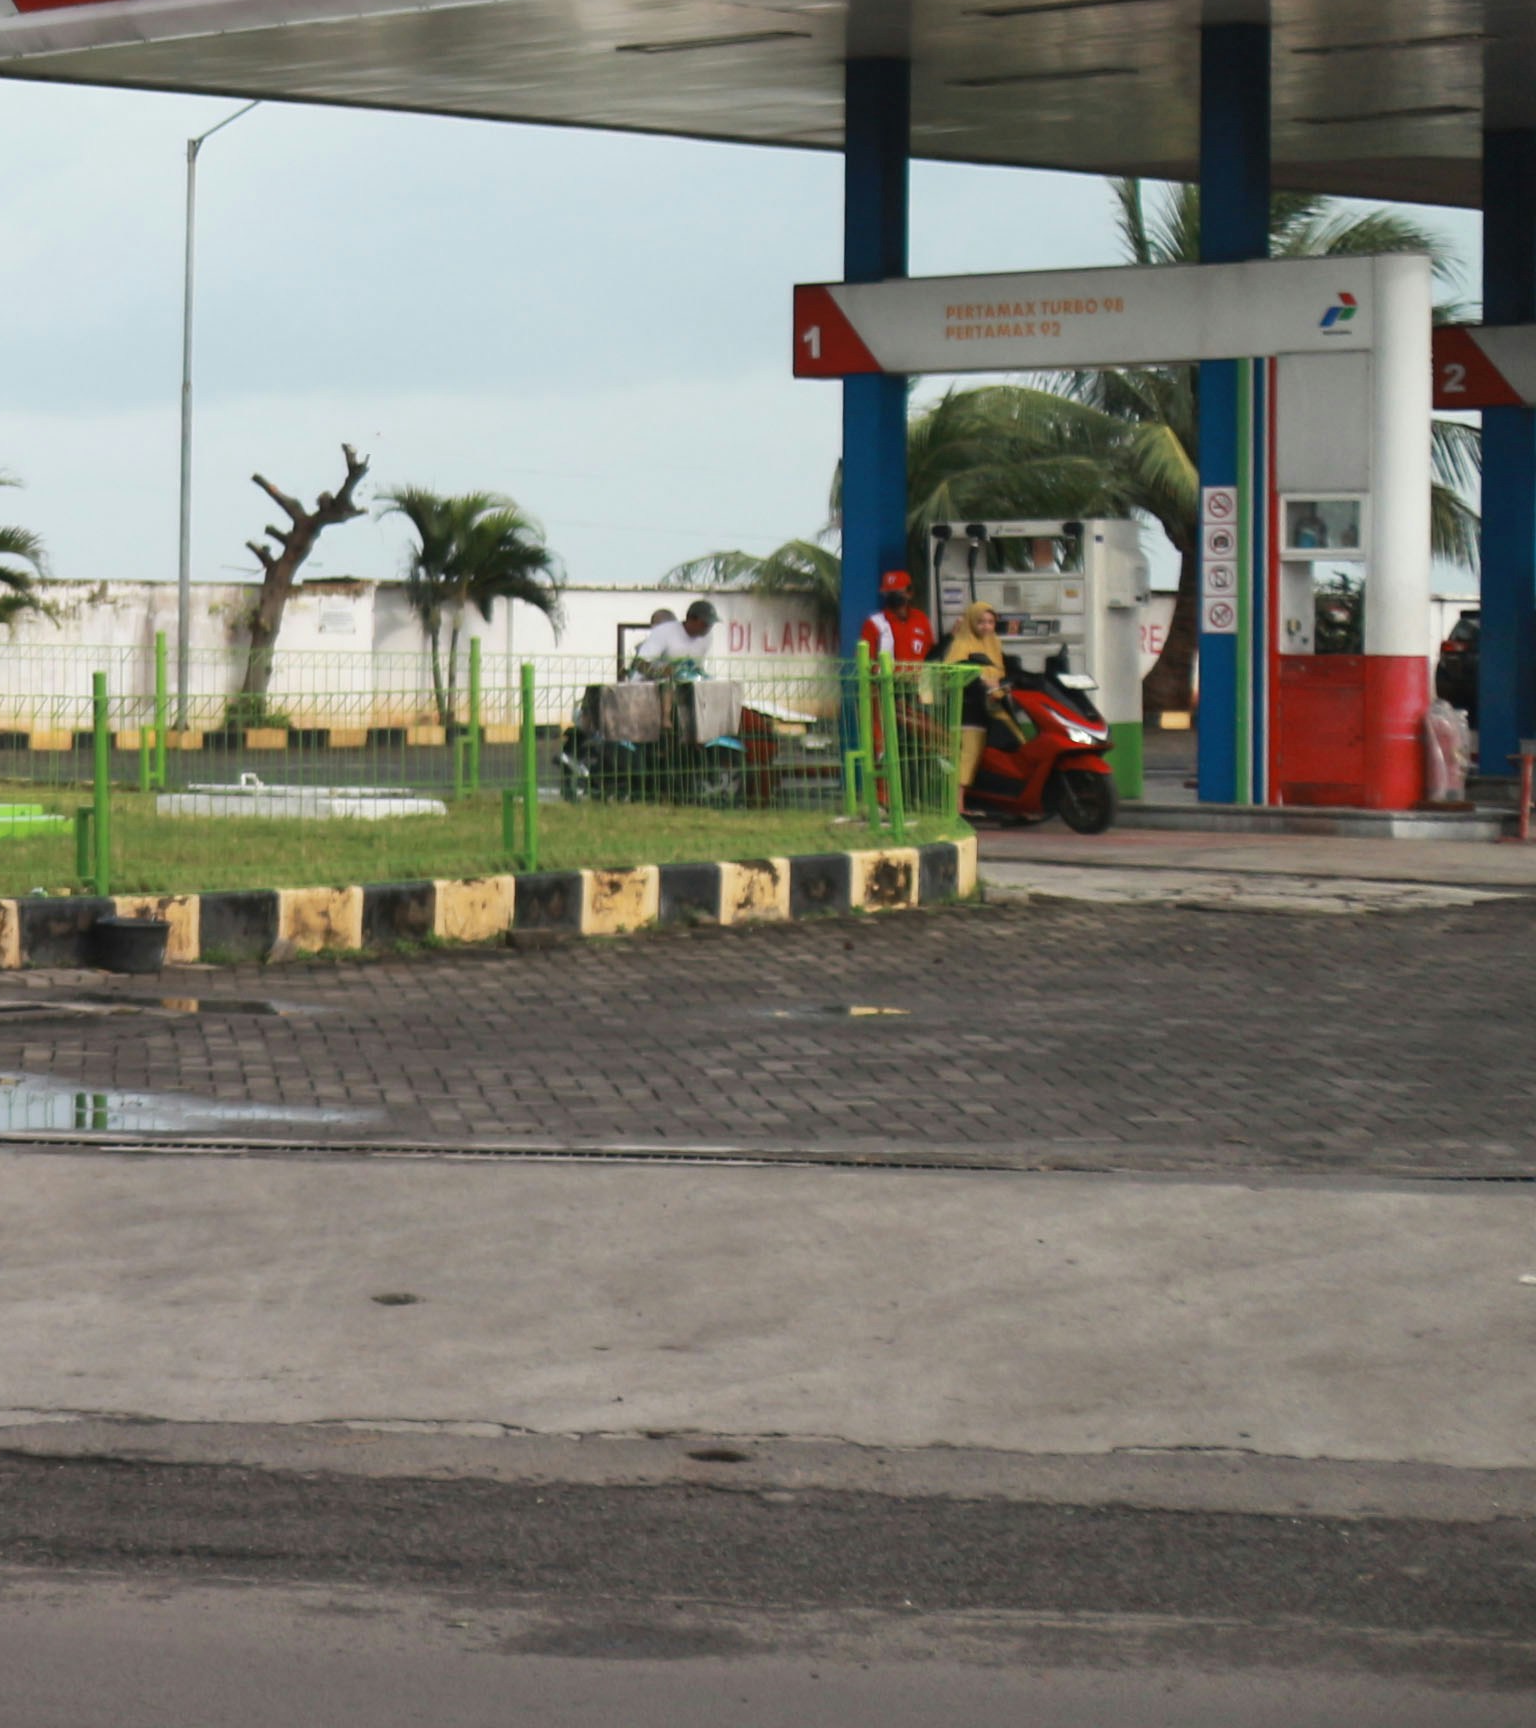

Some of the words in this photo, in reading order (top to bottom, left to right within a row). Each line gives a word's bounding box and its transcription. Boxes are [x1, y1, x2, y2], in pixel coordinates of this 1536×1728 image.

[945, 300, 1036, 320] PERTAMAX
[1040, 298, 1096, 315] TURBO
[802, 326, 821, 359] 1
[945, 322, 1036, 340] PERTAMAX
[1442, 365, 1466, 392] 2
[729, 621, 751, 653] DI
